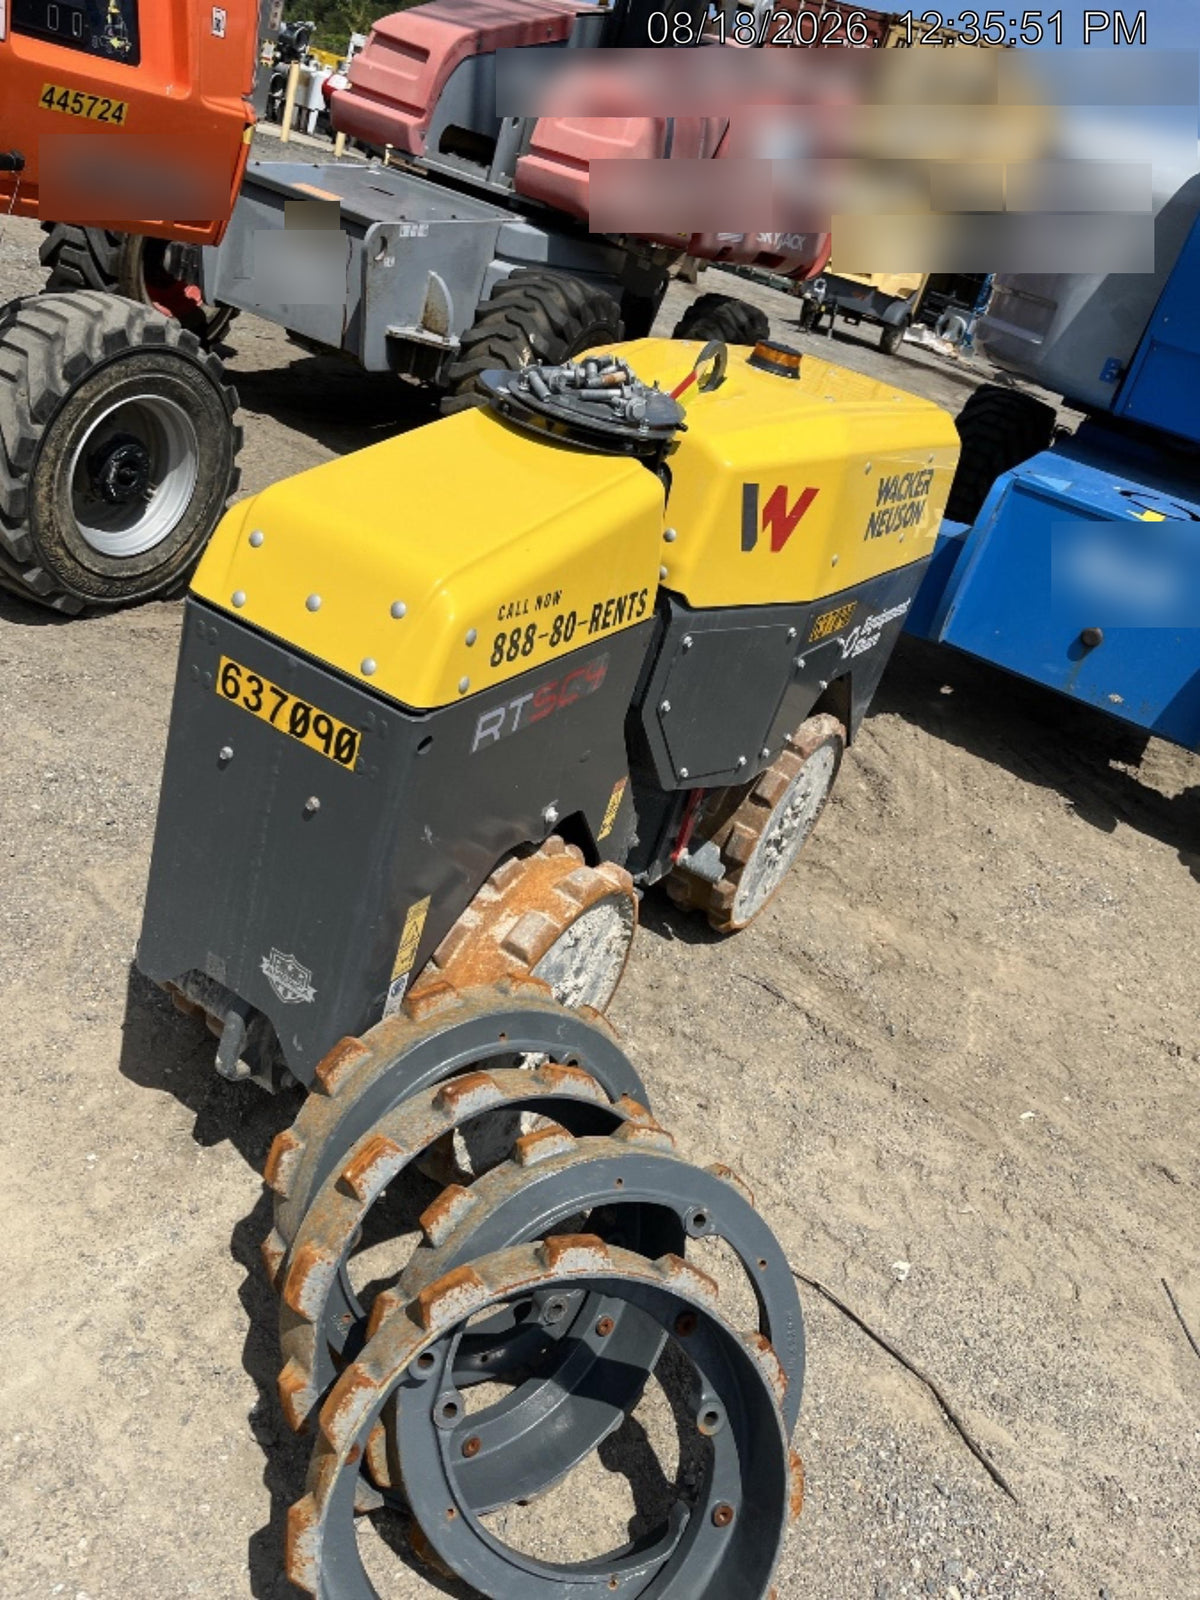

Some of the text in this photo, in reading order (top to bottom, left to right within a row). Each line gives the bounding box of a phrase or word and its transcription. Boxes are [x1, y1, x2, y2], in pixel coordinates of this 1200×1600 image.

[41, 86, 126, 125] 445724
[876, 469, 935, 507] WACKER
[863, 499, 927, 541] NEUSON
[497, 589, 564, 621] CALL NOW
[489, 587, 649, 668] 888-80-RENTS
[220, 662, 359, 766] 637090
